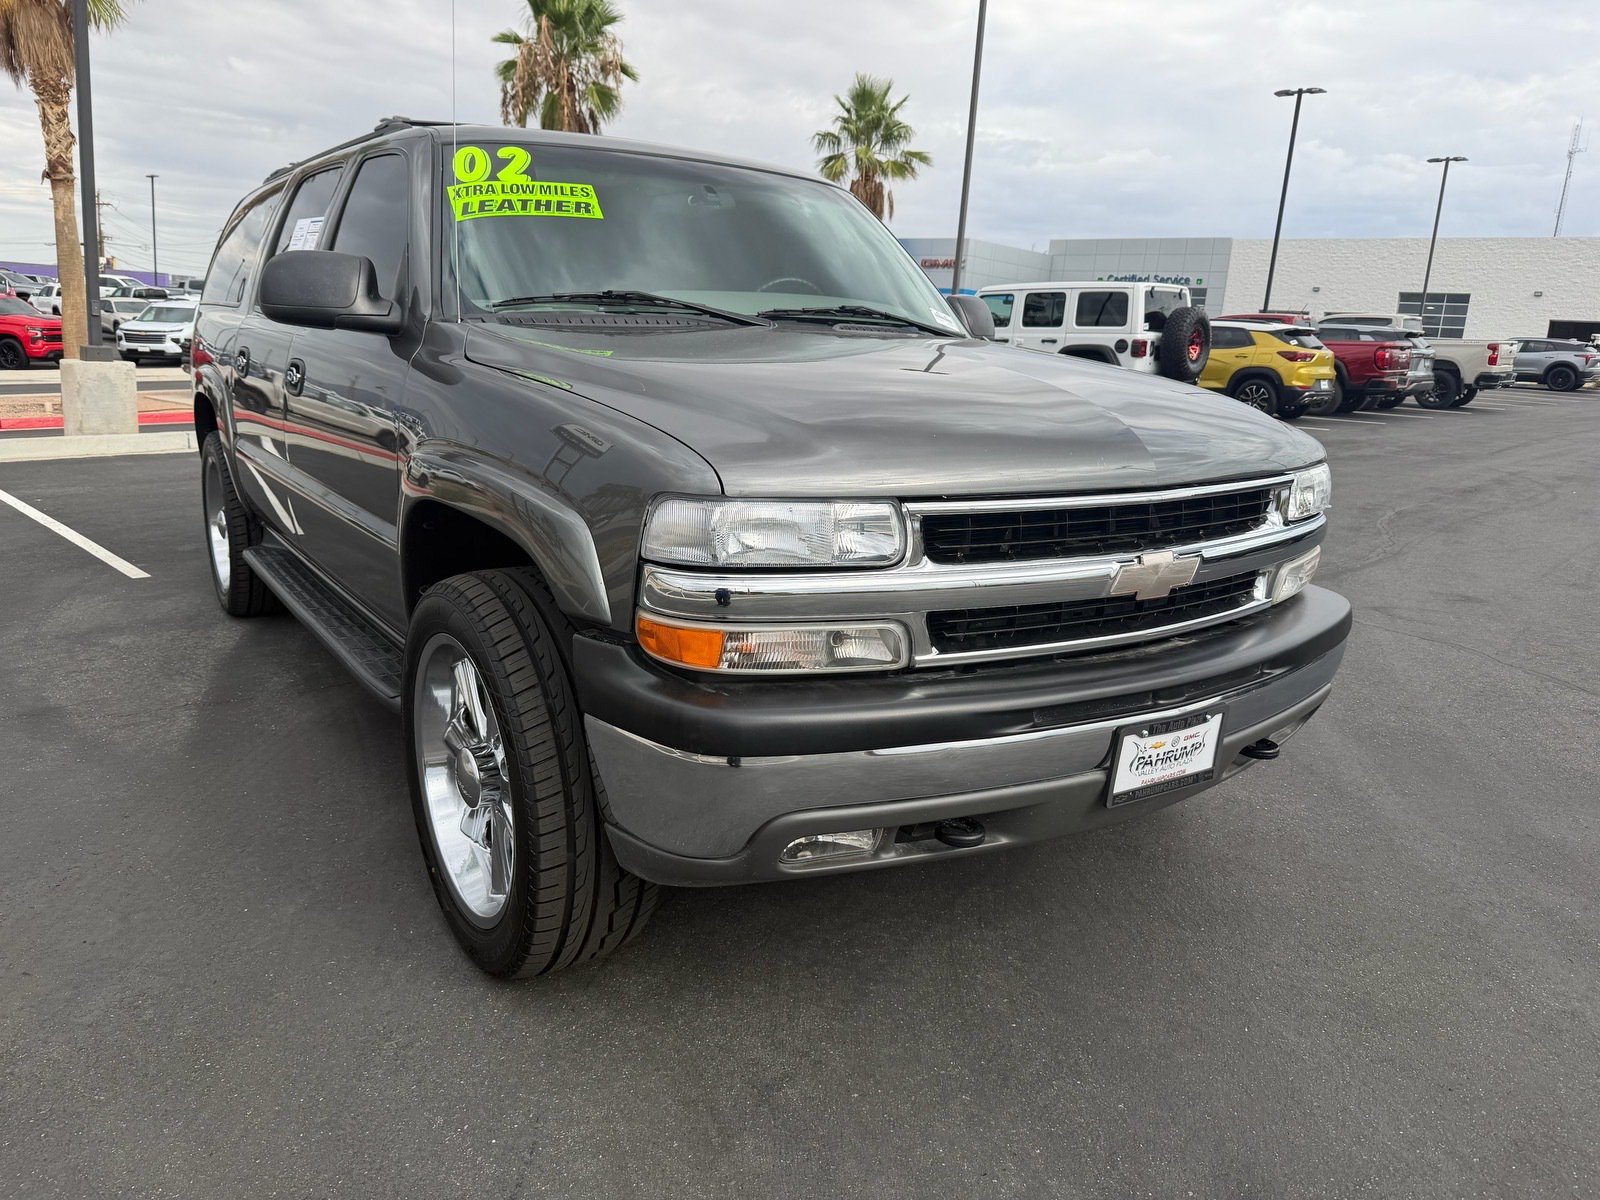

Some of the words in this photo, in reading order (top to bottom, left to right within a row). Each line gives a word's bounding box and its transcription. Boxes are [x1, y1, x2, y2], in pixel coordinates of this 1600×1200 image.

[453, 146, 532, 182] 02
[453, 184, 496, 200] XTRA
[461, 199, 596, 216] LEATHER
[1107, 273, 1150, 283] Certified
[1154, 274, 1191, 285] Service
[1183, 731, 1201, 742] GMC
[1135, 741, 1202, 771] PAHRUMP
